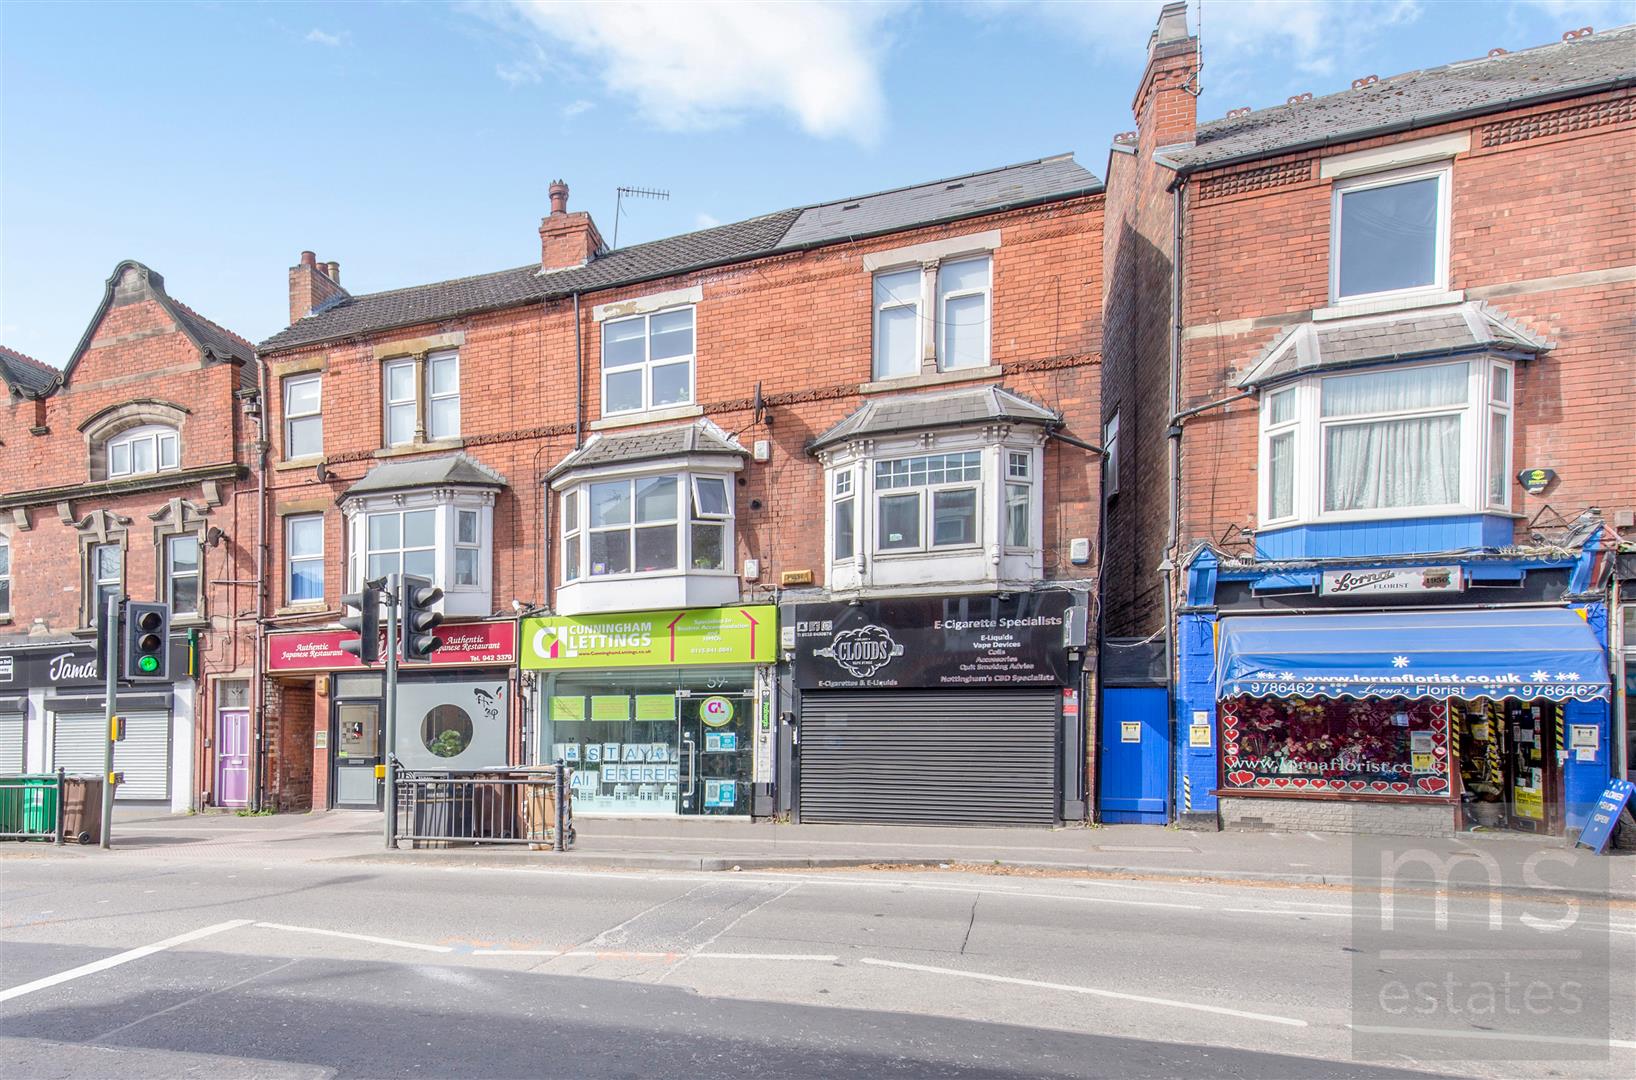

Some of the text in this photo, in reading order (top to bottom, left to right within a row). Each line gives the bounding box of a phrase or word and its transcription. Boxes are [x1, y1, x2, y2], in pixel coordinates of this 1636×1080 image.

[569, 622, 652, 635] CUNNINGHAM
[934, 616, 1062, 630] E-Cigarette Specialists
[446, 635, 484, 644] Authentic
[570, 633, 652, 649] LETTINGS
[296, 642, 328, 651] Authentic
[462, 643, 500, 651] Restaurant
[839, 641, 887, 660] CLOUDS
[281, 649, 343, 660] Japanese Restaurant
[941, 675, 992, 683] Nottingham's
[1303, 674, 1521, 683] www.lornaflorist.co.uk
[1251, 682, 1598, 696] 9786462 Lorna's Florist 9786462
